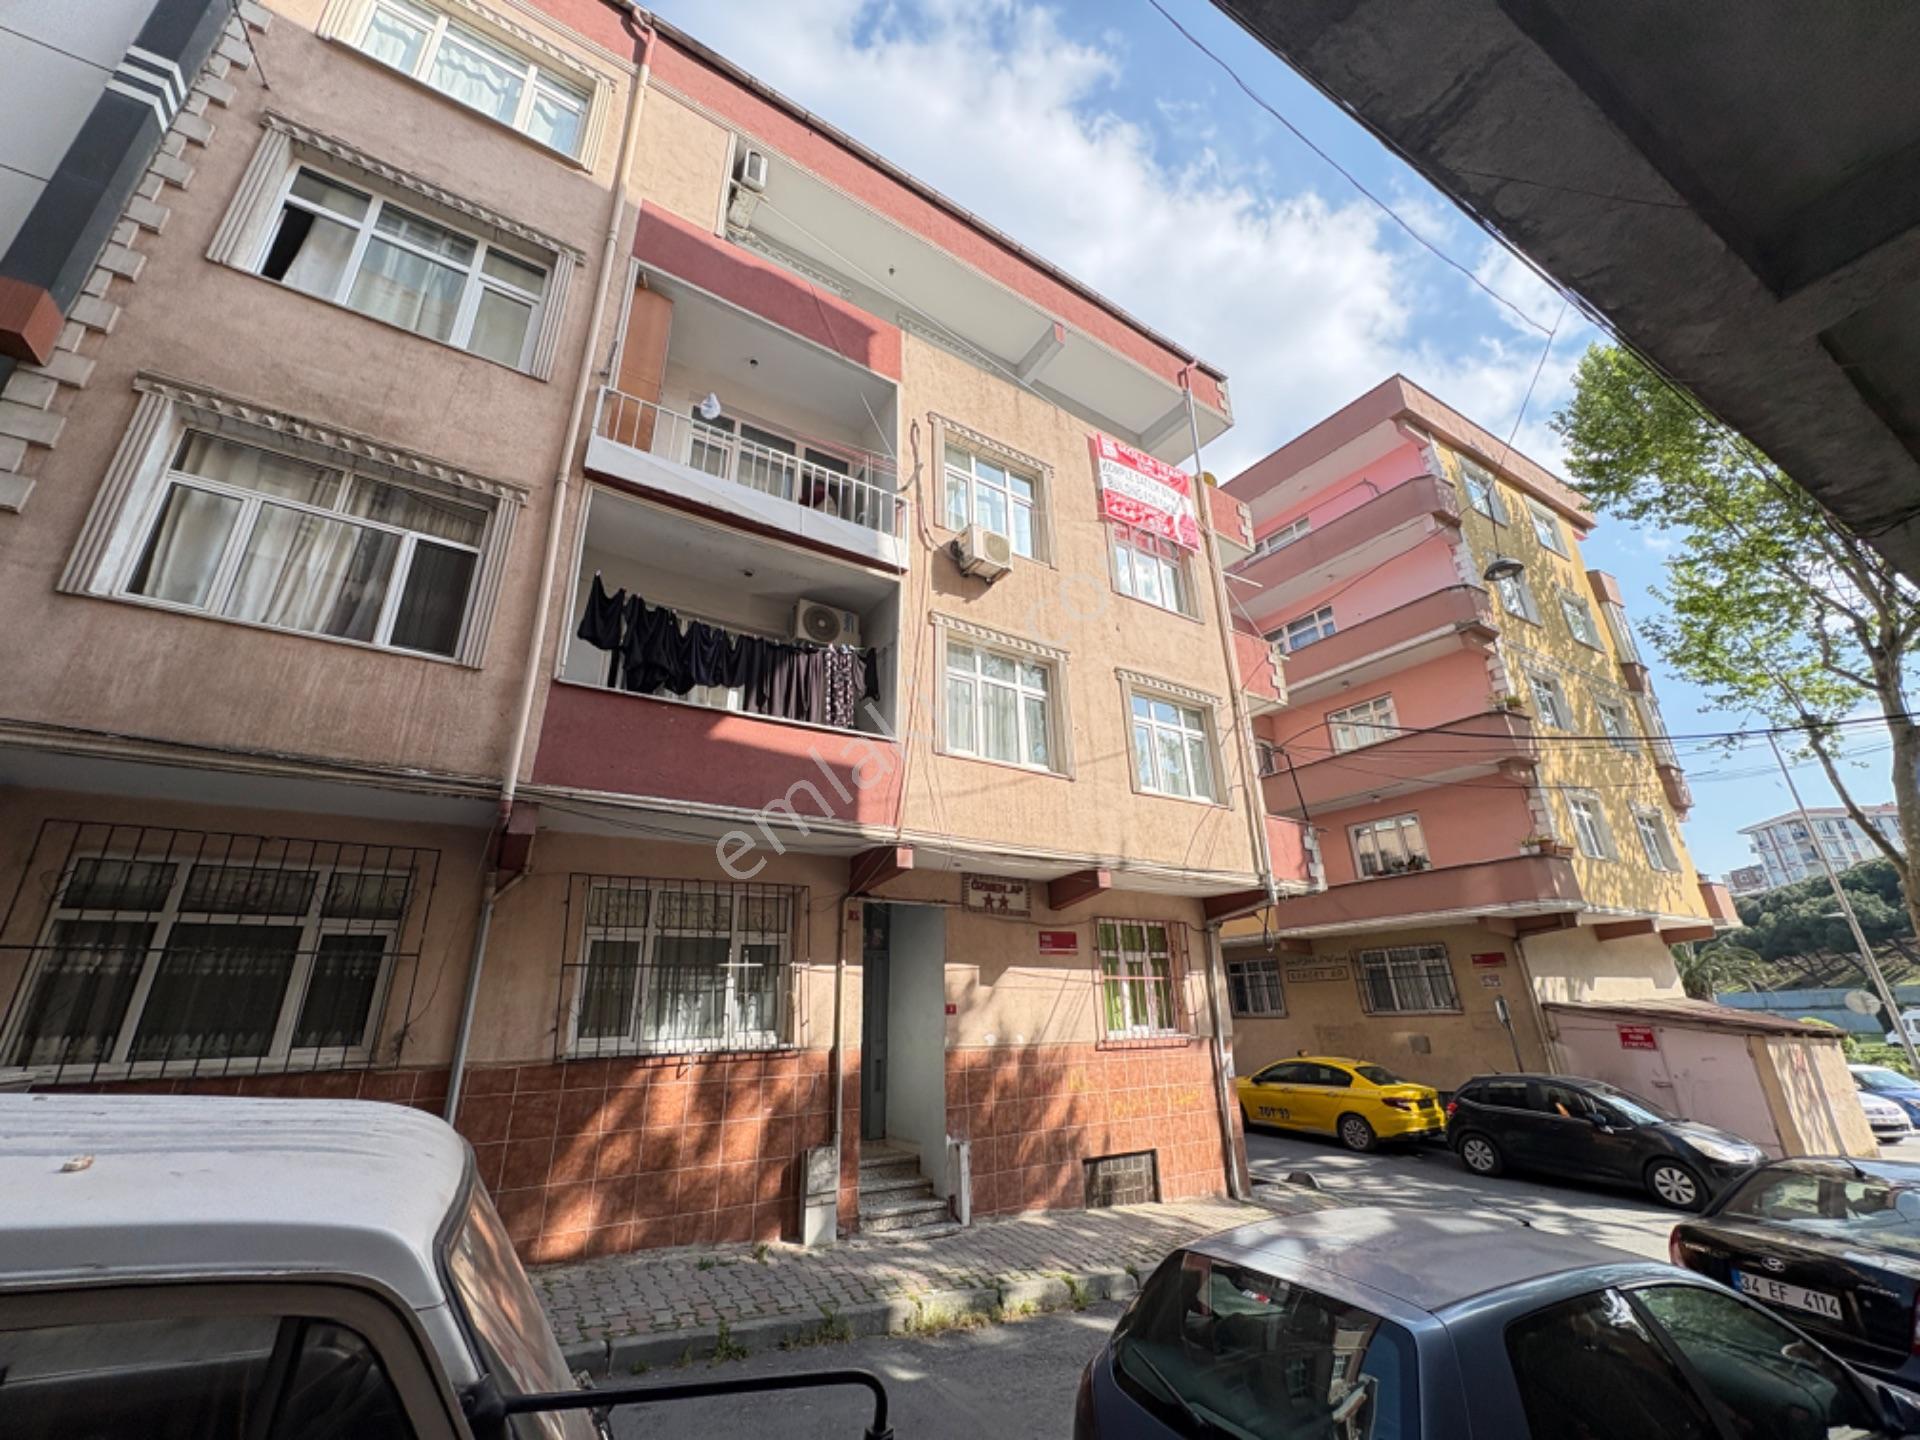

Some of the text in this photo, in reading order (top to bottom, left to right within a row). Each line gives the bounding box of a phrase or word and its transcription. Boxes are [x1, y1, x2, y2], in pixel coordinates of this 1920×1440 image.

[1742, 1274, 1760, 1293] 34
[1769, 1281, 1788, 1301] EF
[1803, 1291, 1839, 1316] 4114
